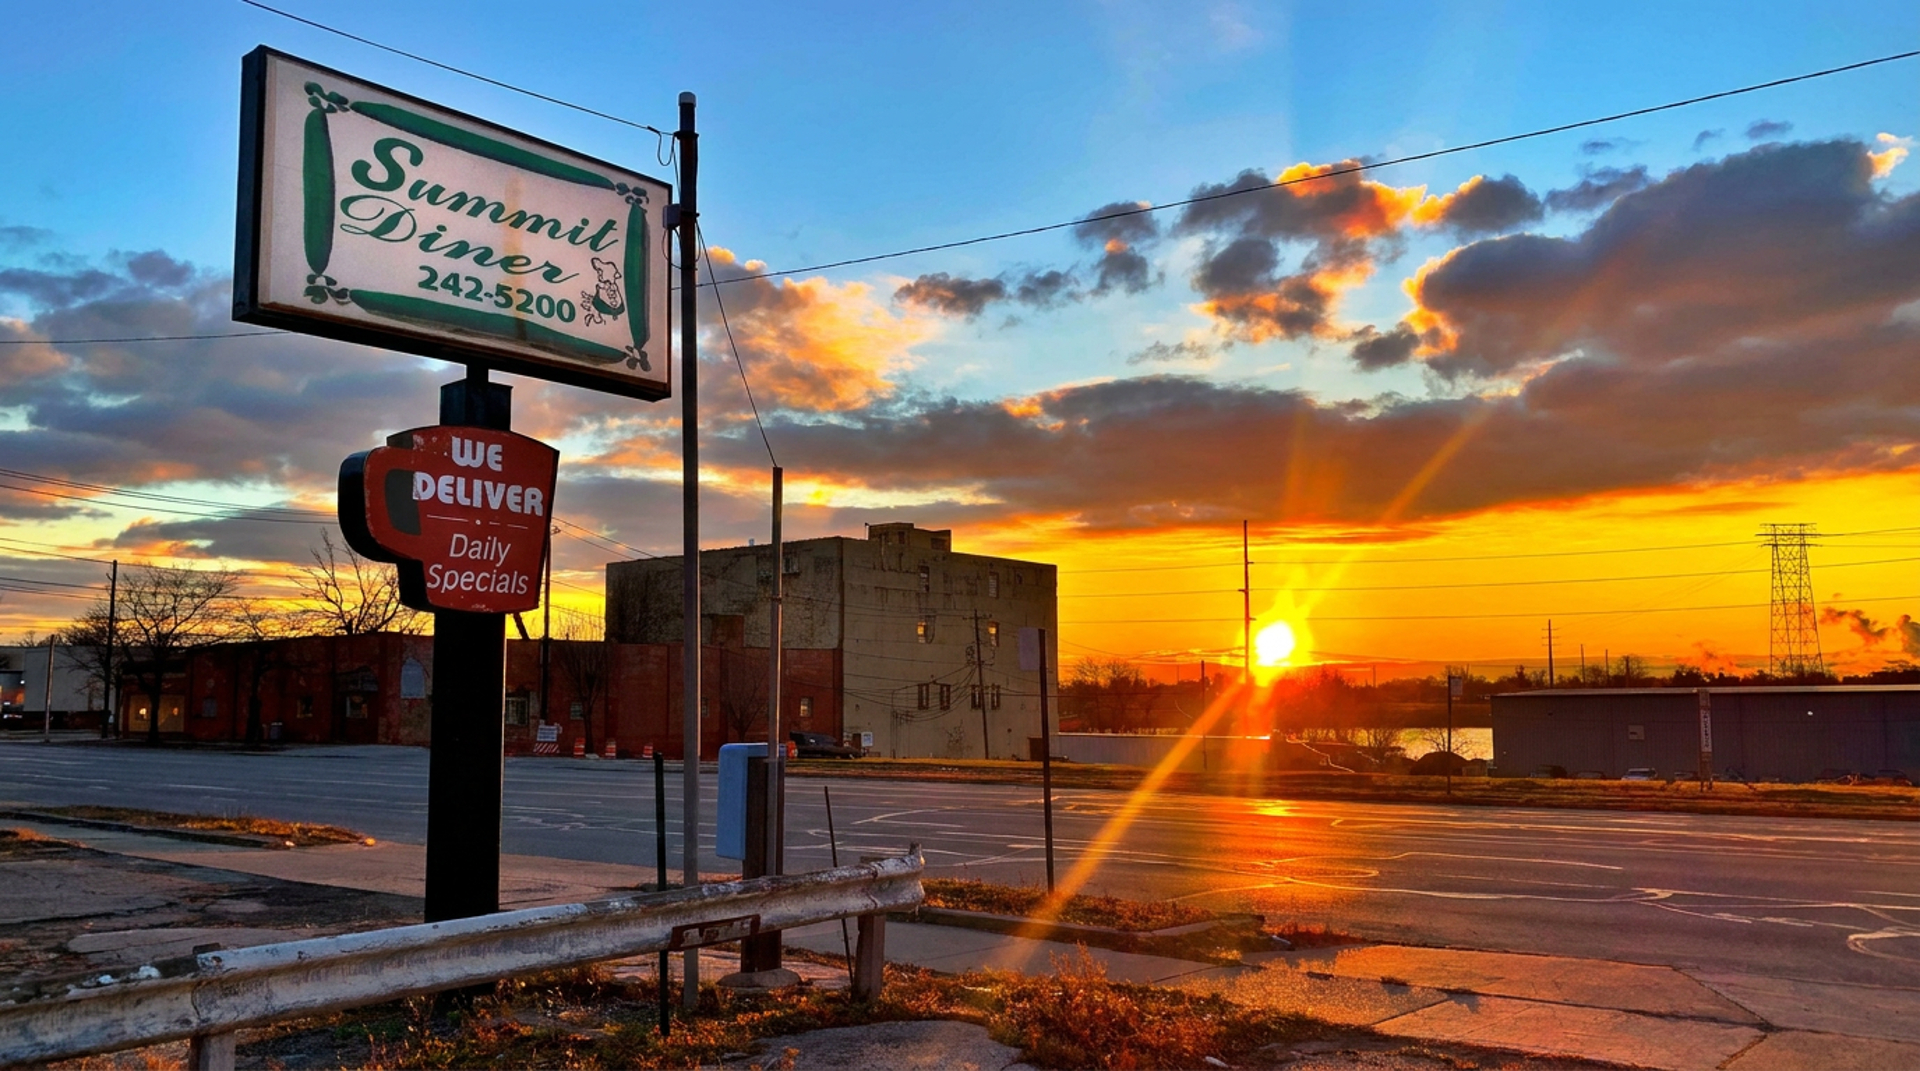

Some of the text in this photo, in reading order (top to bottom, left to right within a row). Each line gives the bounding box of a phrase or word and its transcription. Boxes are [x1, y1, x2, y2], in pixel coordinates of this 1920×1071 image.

[351, 137, 618, 252] Summit
[339, 194, 579, 284] Diner
[417, 265, 576, 323] 242-5200
[451, 436, 503, 471] WE
[412, 471, 544, 516] DELIVER
[449, 533, 511, 567] Daily
[426, 564, 529, 595] Specials
